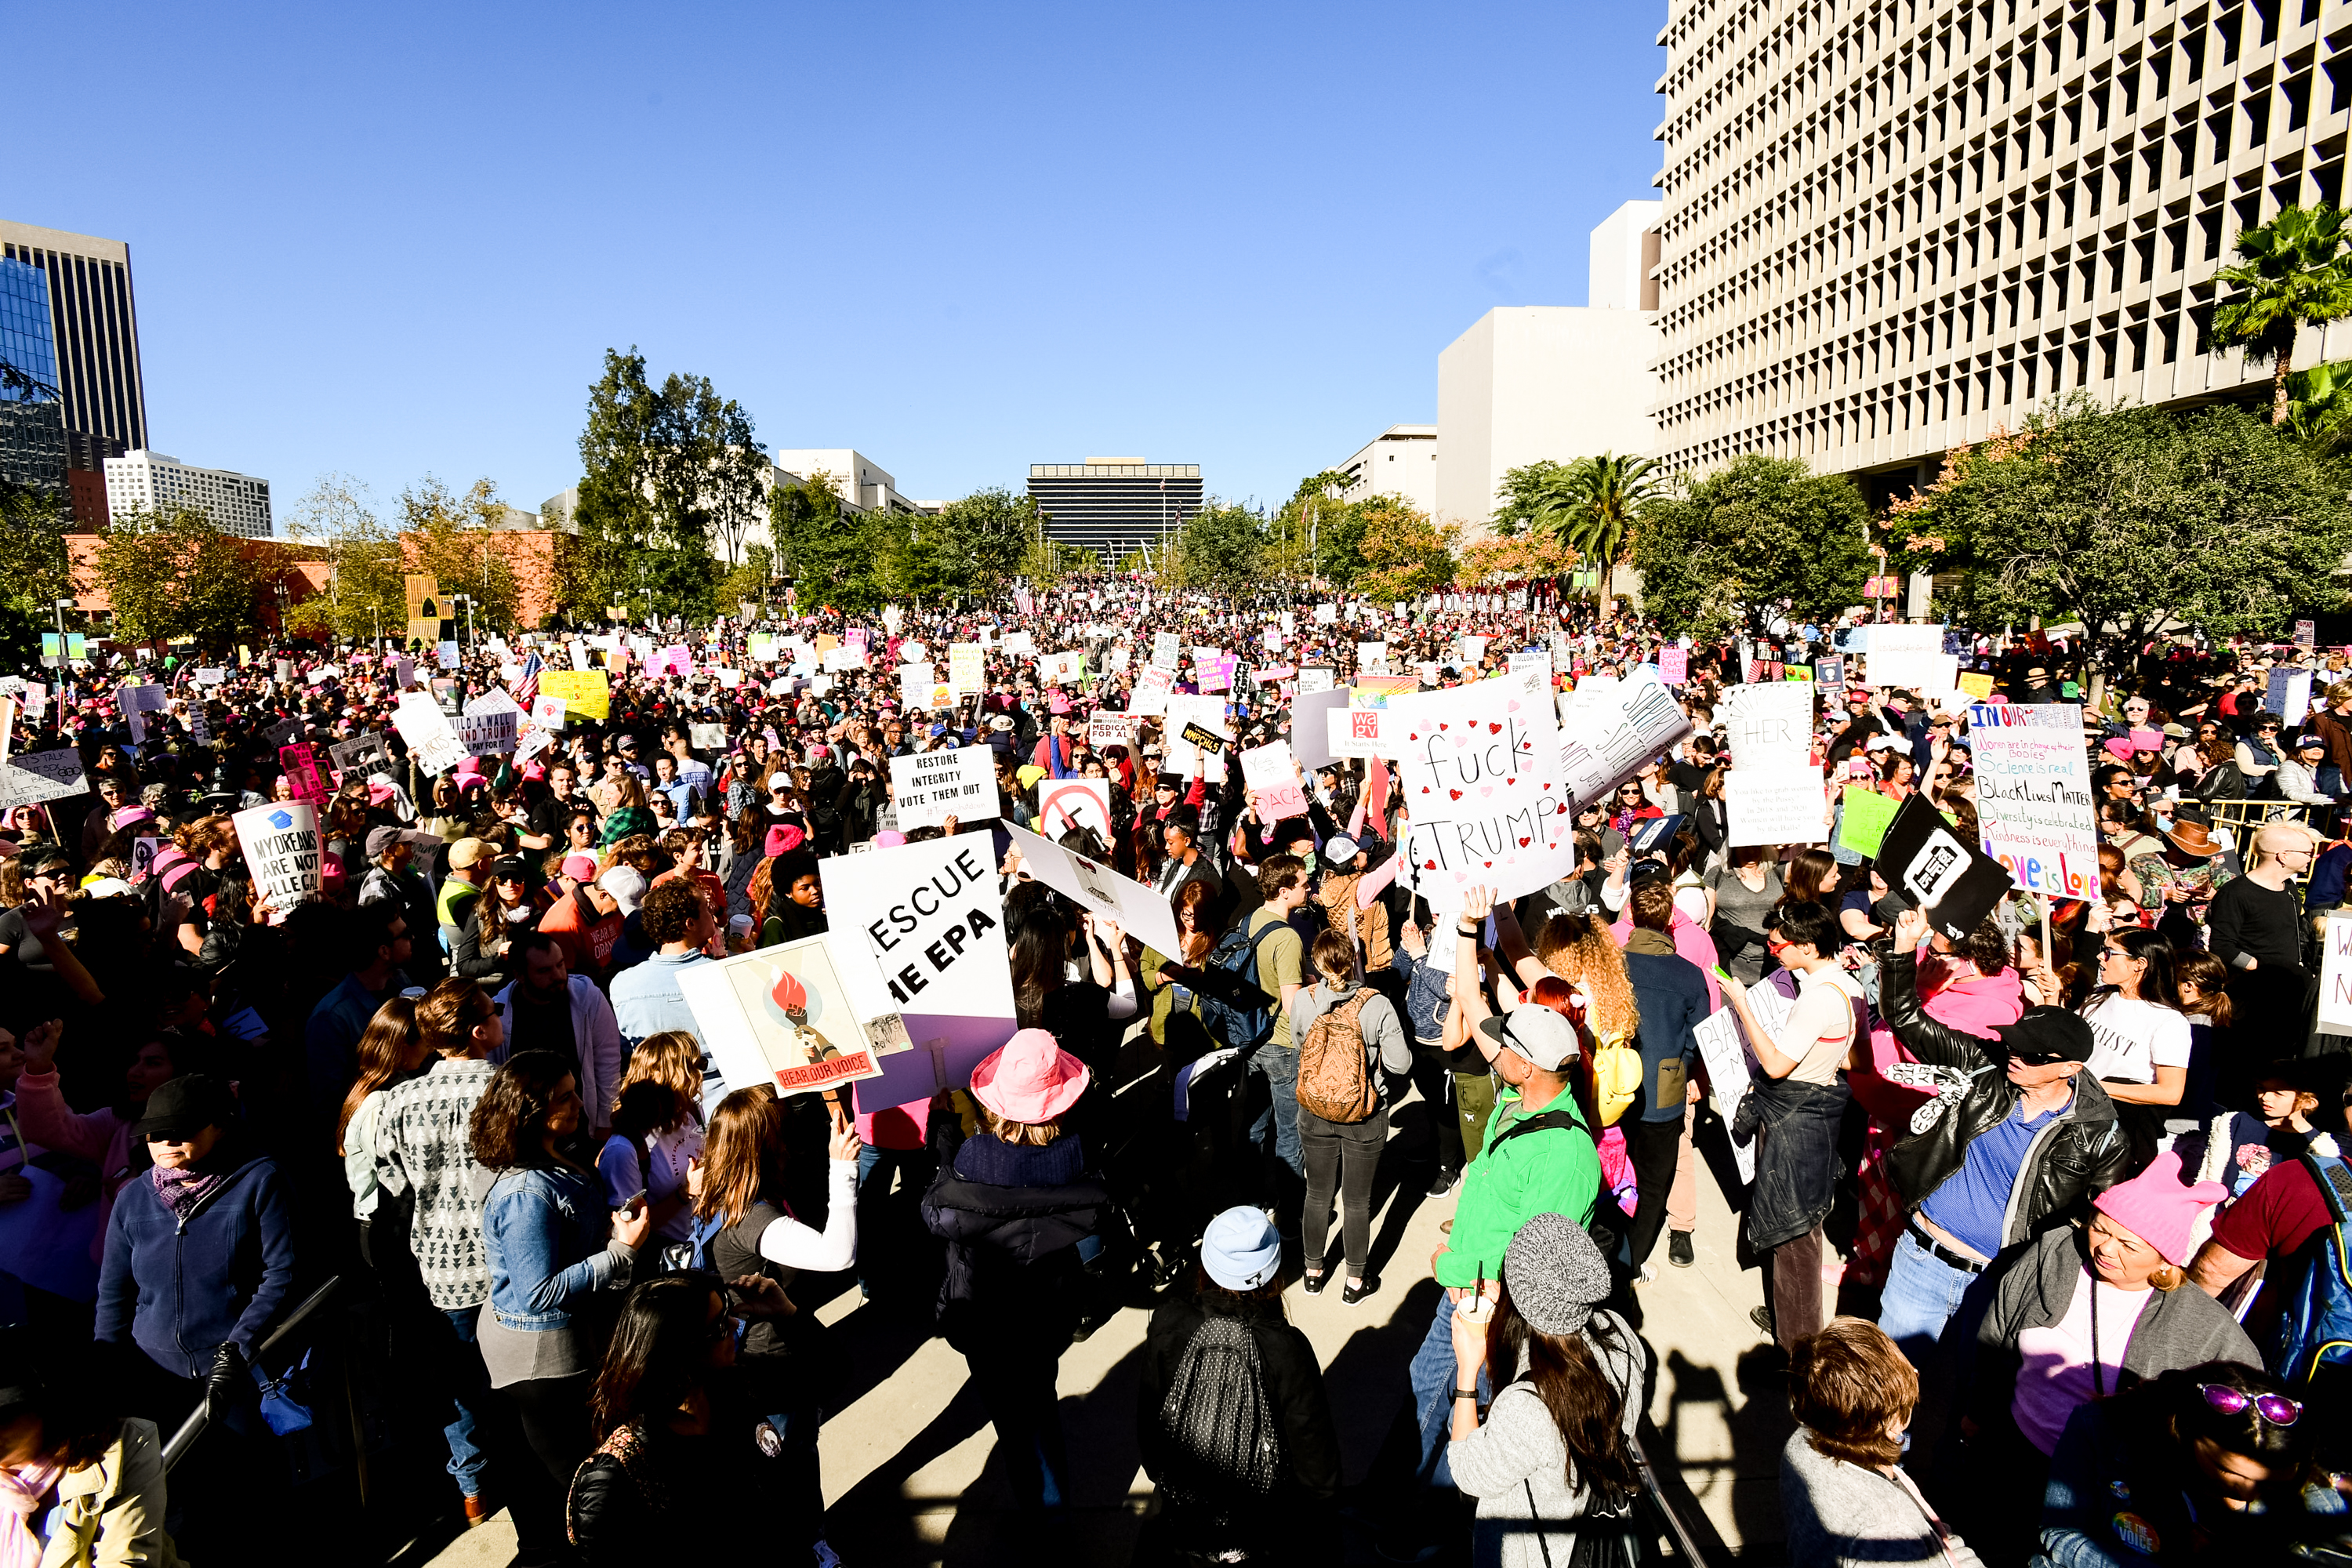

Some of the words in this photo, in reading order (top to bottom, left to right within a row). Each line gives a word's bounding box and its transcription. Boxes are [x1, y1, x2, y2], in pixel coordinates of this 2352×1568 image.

[1156, 642, 1177, 652] SCARED
[1168, 635, 1180, 645] TOO
[1155, 657, 1174, 666] FUNNY
[1197, 659, 1218, 669] STOP
[1219, 656, 1233, 666] ICE
[1199, 666, 1222, 674] RAIDS
[1660, 659, 1686, 668] TOUCH
[1150, 669, 1171, 680] NOW
[1200, 674, 1225, 684] TRUTH
[1663, 666, 1686, 675] THIS!
[1201, 682, 1227, 691] POWER
[1178, 699, 1218, 713] PROTEST
[1622, 682, 1683, 745] SUPPORT
[477, 717, 482, 729] A
[486, 713, 510, 728] WALL
[1192, 714, 1202, 724] IS
[1969, 705, 2001, 728] IN
[2001, 705, 2027, 728] OUR
[2024, 704, 2082, 730] AMERICA
[267, 718, 300, 735] LOVE
[481, 724, 514, 741] TRUMP!
[1744, 718, 1792, 746] HER
[419, 733, 450, 760] STARTS
[472, 742, 485, 751] PAY
[485, 740, 498, 750] FOR
[499, 739, 505, 748] IT
[1183, 728, 1219, 753] MMPCH45
[1969, 728, 2006, 752] Women
[2006, 741, 2020, 750] are
[2020, 739, 2027, 750] in
[2027, 739, 2048, 753] charge
[2048, 742, 2056, 753] of
[2056, 740, 2075, 752] their
[42, 752, 67, 762] TALK
[916, 753, 959, 769] RESTORE
[1978, 752, 2034, 775] Science
[2034, 761, 2045, 774] is
[2048, 761, 2075, 776] real
[13, 764, 42, 778] ABOUT
[1264, 764, 1283, 776] TO
[1561, 741, 1593, 772] NOT
[1579, 771, 1606, 791] JUST
[912, 770, 961, 788] INTEGRITY
[49, 786, 86, 799] EQUALITY
[899, 794, 925, 808] VOTE
[931, 787, 959, 802] THEM
[963, 783, 981, 796] OUT
[1733, 787, 1749, 796] You
[1750, 786, 1764, 795] like
[1765, 786, 1773, 794] to
[1773, 786, 1789, 796] grab
[1762, 795, 1774, 804] the
[925, 802, 986, 818] #TrumpShutdown
[1254, 786, 1303, 818] DACA
[1755, 805, 1774, 814] 2018
[1775, 804, 1788, 813] and
[1790, 804, 1808, 812] 2020
[1740, 815, 1768, 824] Women
[1769, 814, 1784, 823] will
[1784, 814, 1802, 822] have
[1978, 798, 2033, 831] Diversity
[2033, 811, 2043, 824] is
[2043, 809, 2094, 833] celebrated
[1414, 796, 1558, 871] TRUMP
[1756, 826, 1766, 834] by
[1780, 823, 1801, 832] Balls!
[254, 837, 273, 860] MY
[274, 829, 318, 855] DREAMS
[1980, 818, 2031, 845] Kindness
[2031, 833, 2042, 846] is
[2042, 832, 2096, 863] everything
[1935, 847, 1955, 867] RISE
[263, 858, 290, 880] ARE
[294, 853, 318, 872] NOT
[1925, 857, 1945, 877] UP
[1917, 872, 1933, 889] AS
[2043, 865, 2062, 894] is
[2058, 851, 2100, 900] Love
[267, 873, 318, 898] ILLEGAL
[868, 848, 985, 959] ESCUE
[590, 927, 610, 944] WEAR
[924, 908, 997, 974] EPA
[779, 1068, 811, 1087] HEAR
[810, 1063, 833, 1083] OUR
[832, 1054, 868, 1076] VOICE
[673, 1138, 685, 1152] SPARK
[674, 1168, 680, 1177] BE
[2123, 1519, 2132, 1531] BE
[2135, 1523, 2149, 1537] THE
[2118, 1525, 2154, 1553] VOICE
